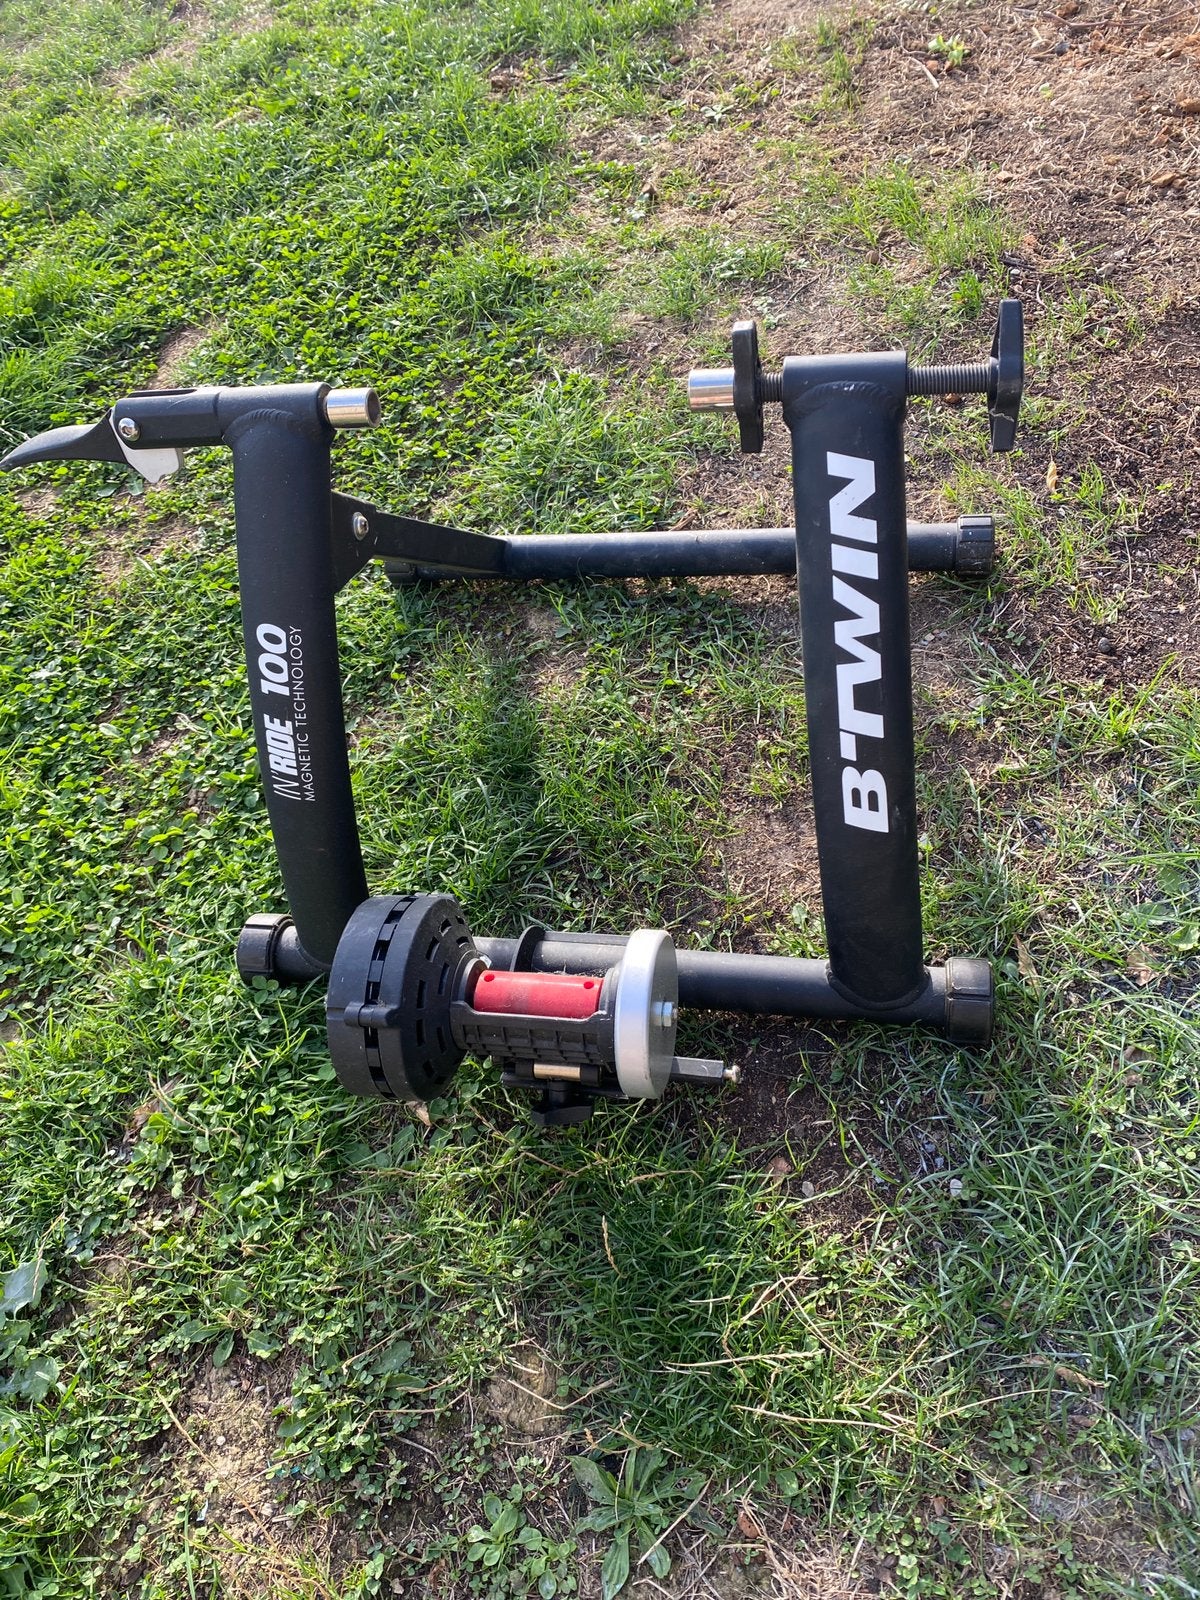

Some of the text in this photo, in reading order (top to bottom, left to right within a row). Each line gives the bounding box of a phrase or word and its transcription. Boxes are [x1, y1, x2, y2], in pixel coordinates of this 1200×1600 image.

[256, 623, 290, 696] 100
[289, 625, 316, 801] MAGNETIC TECHNOLOGY
